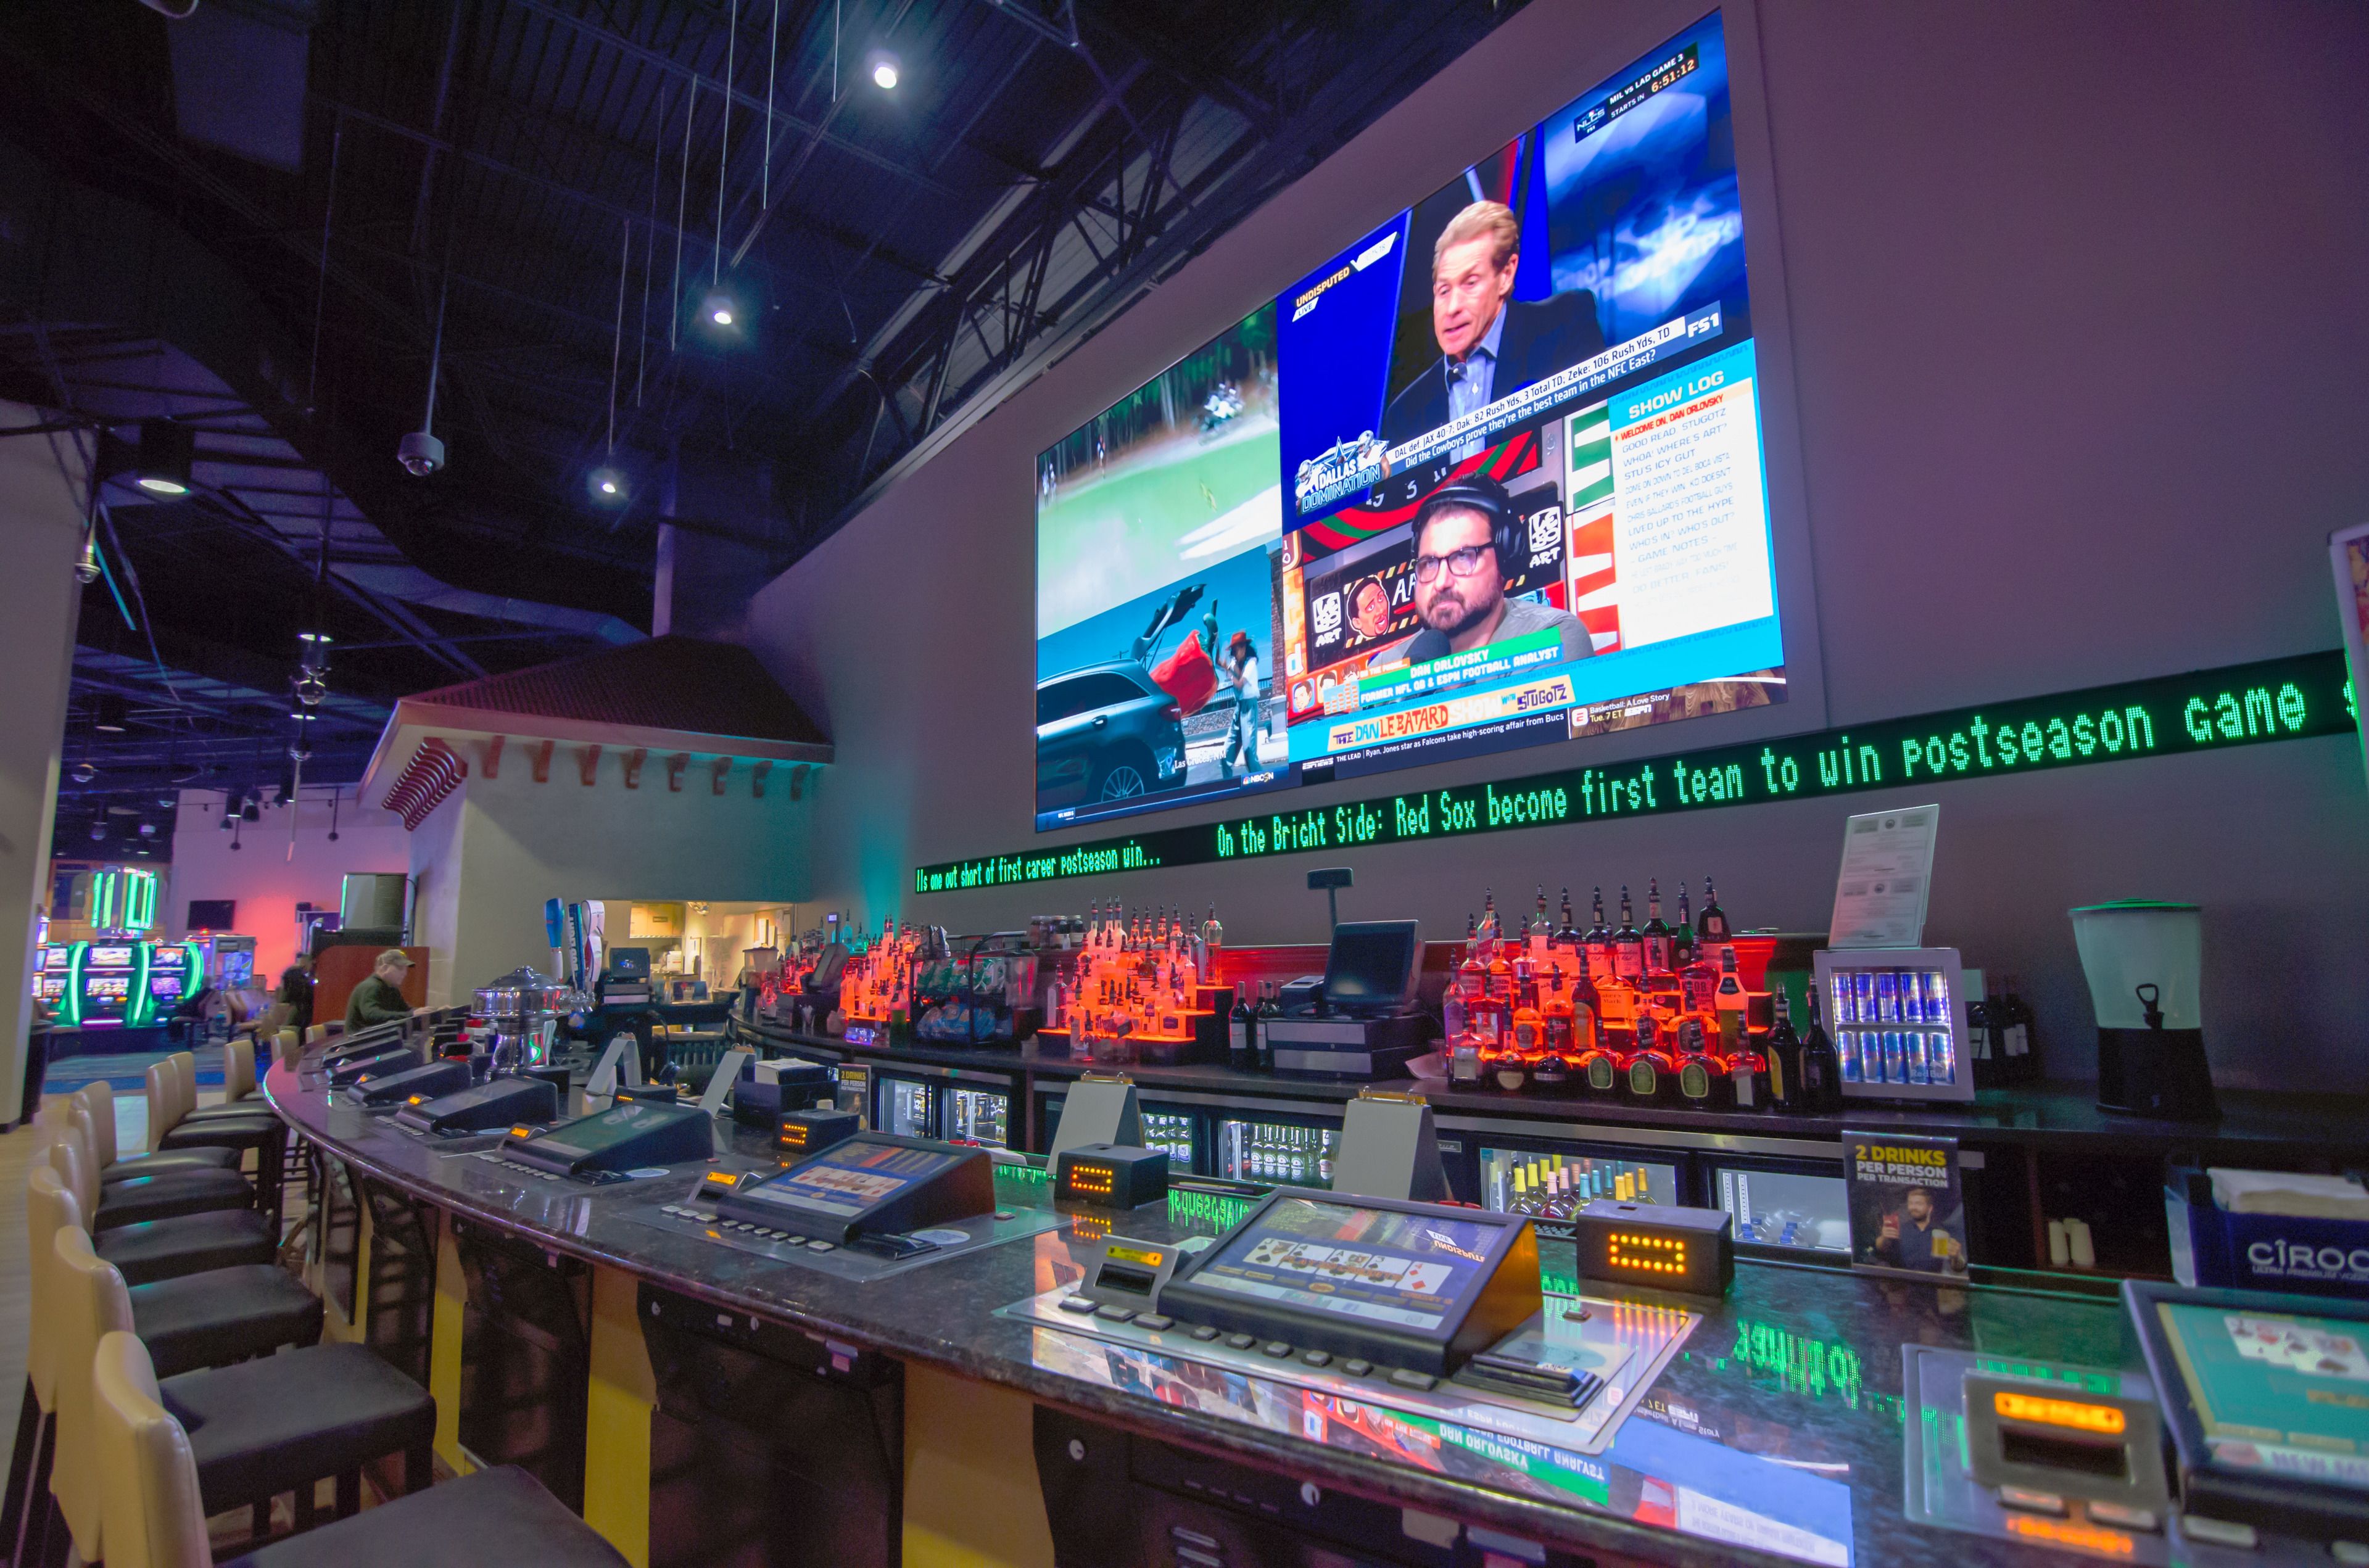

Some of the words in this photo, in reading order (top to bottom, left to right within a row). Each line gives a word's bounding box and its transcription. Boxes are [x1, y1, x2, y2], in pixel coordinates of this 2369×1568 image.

[1610, 93, 1624, 105] MIL
[1625, 85, 1634, 95] vs
[1635, 73, 1651, 89] LAD
[1652, 57, 1676, 77] GAME
[1677, 53, 1683, 62] 3
[1652, 59, 1695, 93] 6:51:12
[1577, 108, 1605, 131] NLCS
[1611, 98, 1636, 118] STARTS
[1637, 93, 1645, 102] IN
[1296, 266, 1350, 307] UNDISPUTED
[1298, 303, 1312, 316] LIVE
[1688, 312, 1719, 338] FS1
[1395, 447, 1407, 458] DAL
[1423, 434, 1434, 448] JAX
[1457, 418, 1472, 431] Dak:
[1474, 411, 1484, 422] 82
[1486, 402, 1505, 418] Rush
[1524, 390, 1529, 400] 3
[1531, 382, 1550, 397] Total
[1552, 375, 1565, 387] TD;
[1568, 365, 1590, 381] Zeke:
[1594, 355, 1609, 369] 106
[1612, 343, 1634, 361] Rush
[1636, 335, 1655, 350] Yds,
[1658, 327, 1669, 340] TD
[1629, 386, 1682, 419] SHOW
[1688, 370, 1724, 395] LOG
[1405, 455, 1417, 468] Did
[1418, 449, 1431, 462] the
[1432, 436, 1464, 455] Cowboys
[1466, 426, 1487, 444] prove
[1489, 411, 1516, 431] they're
[1518, 404, 1532, 419] the
[1534, 396, 1552, 413] best
[1554, 386, 1577, 403] team
[1579, 380, 1588, 392] in
[1590, 372, 1606, 387] the
[1608, 361, 1627, 379] NFC
[1629, 349, 1656, 370] East?
[1621, 421, 1654, 440] WELCOME
[1655, 416, 1668, 429] ON,
[1669, 409, 1685, 423] DAN
[1686, 394, 1724, 416] ORLOVSKY
[1623, 437, 1648, 453] GOOD
[1682, 408, 1727, 431] STUGOTZ
[1319, 459, 1357, 488] DALLAS
[1624, 464, 1652, 480] STU'S
[1655, 458, 1671, 469] ICY
[1674, 448, 1695, 462] GUT
[1643, 479, 1652, 489] ON
[1653, 472, 1671, 485] DOWN
[1673, 469, 1681, 477] TO
[1695, 458, 1711, 471] BOCA
[1713, 452, 1730, 464] VISTA
[1302, 463, 1381, 514] DOMINATION
[1626, 496, 1643, 508] EVEN
[1653, 487, 1669, 499] THEY
[1627, 510, 1645, 523] CHRIS
[1681, 489, 1713, 506] FOOTBALL
[1714, 482, 1733, 494] GUYS
[1628, 522, 1653, 536] LIVED
[1656, 517, 1669, 528] UP
[1671, 512, 1684, 523] TO
[1686, 506, 1704, 518] THE
[1708, 496, 1734, 511] HYPE
[1677, 519, 1708, 536] WHO'S
[1711, 511, 1735, 526] OUT?
[1529, 547, 1561, 568] ART
[1638, 547, 1669, 563] GAME
[1672, 535, 1708, 553] NOTES
[1315, 627, 1342, 647] ART
[1360, 688, 1394, 704] FORMER
[1395, 683, 1412, 696] NFL
[1414, 679, 1425, 691] QB
[1428, 677, 1434, 688] &
[1436, 672, 1460, 685] ESPN
[1463, 660, 1511, 680] FOOTBALL
[1513, 646, 1559, 667] ANALYST
[1410, 664, 1431, 679] DAN
[1434, 649, 1489, 674] ORLOVSKY
[1333, 732, 1354, 745] THE
[1355, 721, 1379, 741] DAN
[1450, 695, 1502, 724] SHOW
[1501, 693, 1516, 705] WITH
[1518, 684, 1567, 711] STUGOTZ
[1589, 714, 1605, 722] Tue.
[1611, 709, 1623, 719] ET
[1624, 704, 1652, 717] ESPN
[1590, 701, 1626, 714] Basketball:
[1627, 699, 1632, 707] A
[1634, 697, 1648, 706] Love
[1650, 693, 1670, 703] Story
[1347, 752, 1361, 761] LEAD
[1383, 745, 1400, 754] Jones
[1401, 742, 1413, 750] star
[1422, 735, 1445, 746] Falcons
[1447, 732, 1462, 741] take
[1463, 724, 1505, 739] high-scoring
[1506, 720, 1525, 730] affair
[1526, 717, 1544, 727] from
[1546, 712, 1564, 723] Bucs
[1174, 759, 1186, 769] Las
[1187, 754, 1212, 767] Cruces,
[1213, 750, 1226, 760] NM
[1218, 824, 1233, 856] On
[1241, 820, 1265, 854] the
[1273, 811, 1326, 851] Bright
[1336, 803, 1383, 843] Side:
[1396, 794, 1429, 836] Red
[1440, 790, 1476, 830] Sox
[1487, 785, 1567, 826] become
[1582, 764, 1656, 814] first
[1674, 761, 1743, 804] team
[1761, 748, 1799, 793] to
[1819, 736, 1880, 787] win
[931, 872, 943, 890] one
[946, 866, 957, 889] out
[961, 862, 982, 888] short
[986, 859, 994, 884] of
[999, 856, 1022, 882] first
[1026, 858, 1056, 880] career
[1123, 840, 1160, 868] win...
[1912, 1068, 1927, 1078] Red
[1855, 1144, 1867, 1160] 2
[1871, 1145, 1946, 1166] DRINKS
[1856, 1161, 1884, 1174] PER
[1887, 1163, 1946, 1179] PERSON
[1857, 1172, 1876, 1182] PER
[1877, 1174, 1948, 1189] TRANSACTION
